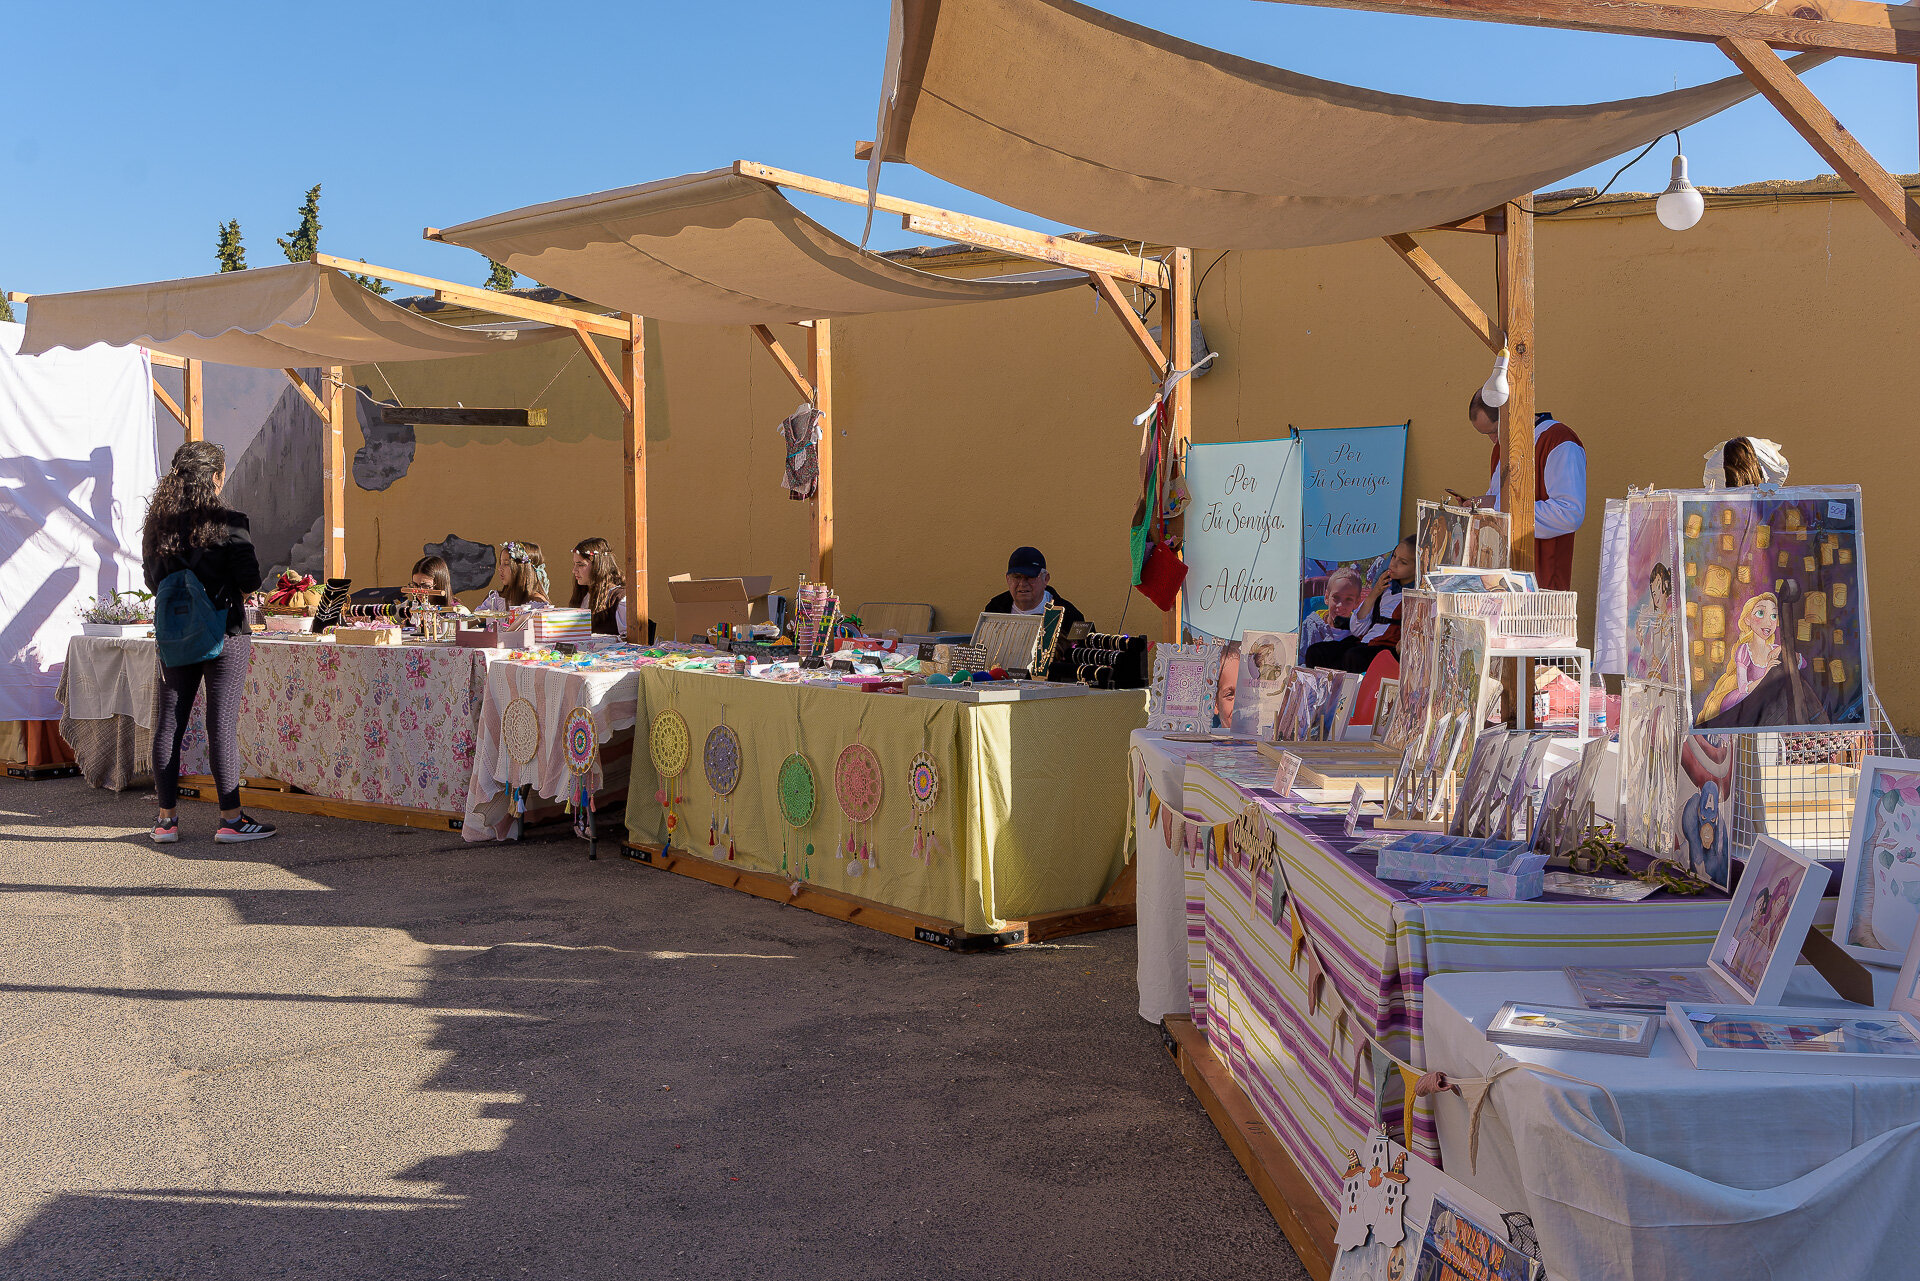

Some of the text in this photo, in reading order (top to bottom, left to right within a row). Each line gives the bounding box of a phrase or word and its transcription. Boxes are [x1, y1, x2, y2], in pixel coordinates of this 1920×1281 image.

[1329, 443, 1362, 465] Por
[1224, 463, 1258, 496] Por
[1303, 468, 1390, 496] Tú Sonrisa.
[1202, 501, 1285, 543] Tú Sonrisa.
[1303, 512, 1381, 543] Adrián
[1200, 567, 1278, 611] Adrián
